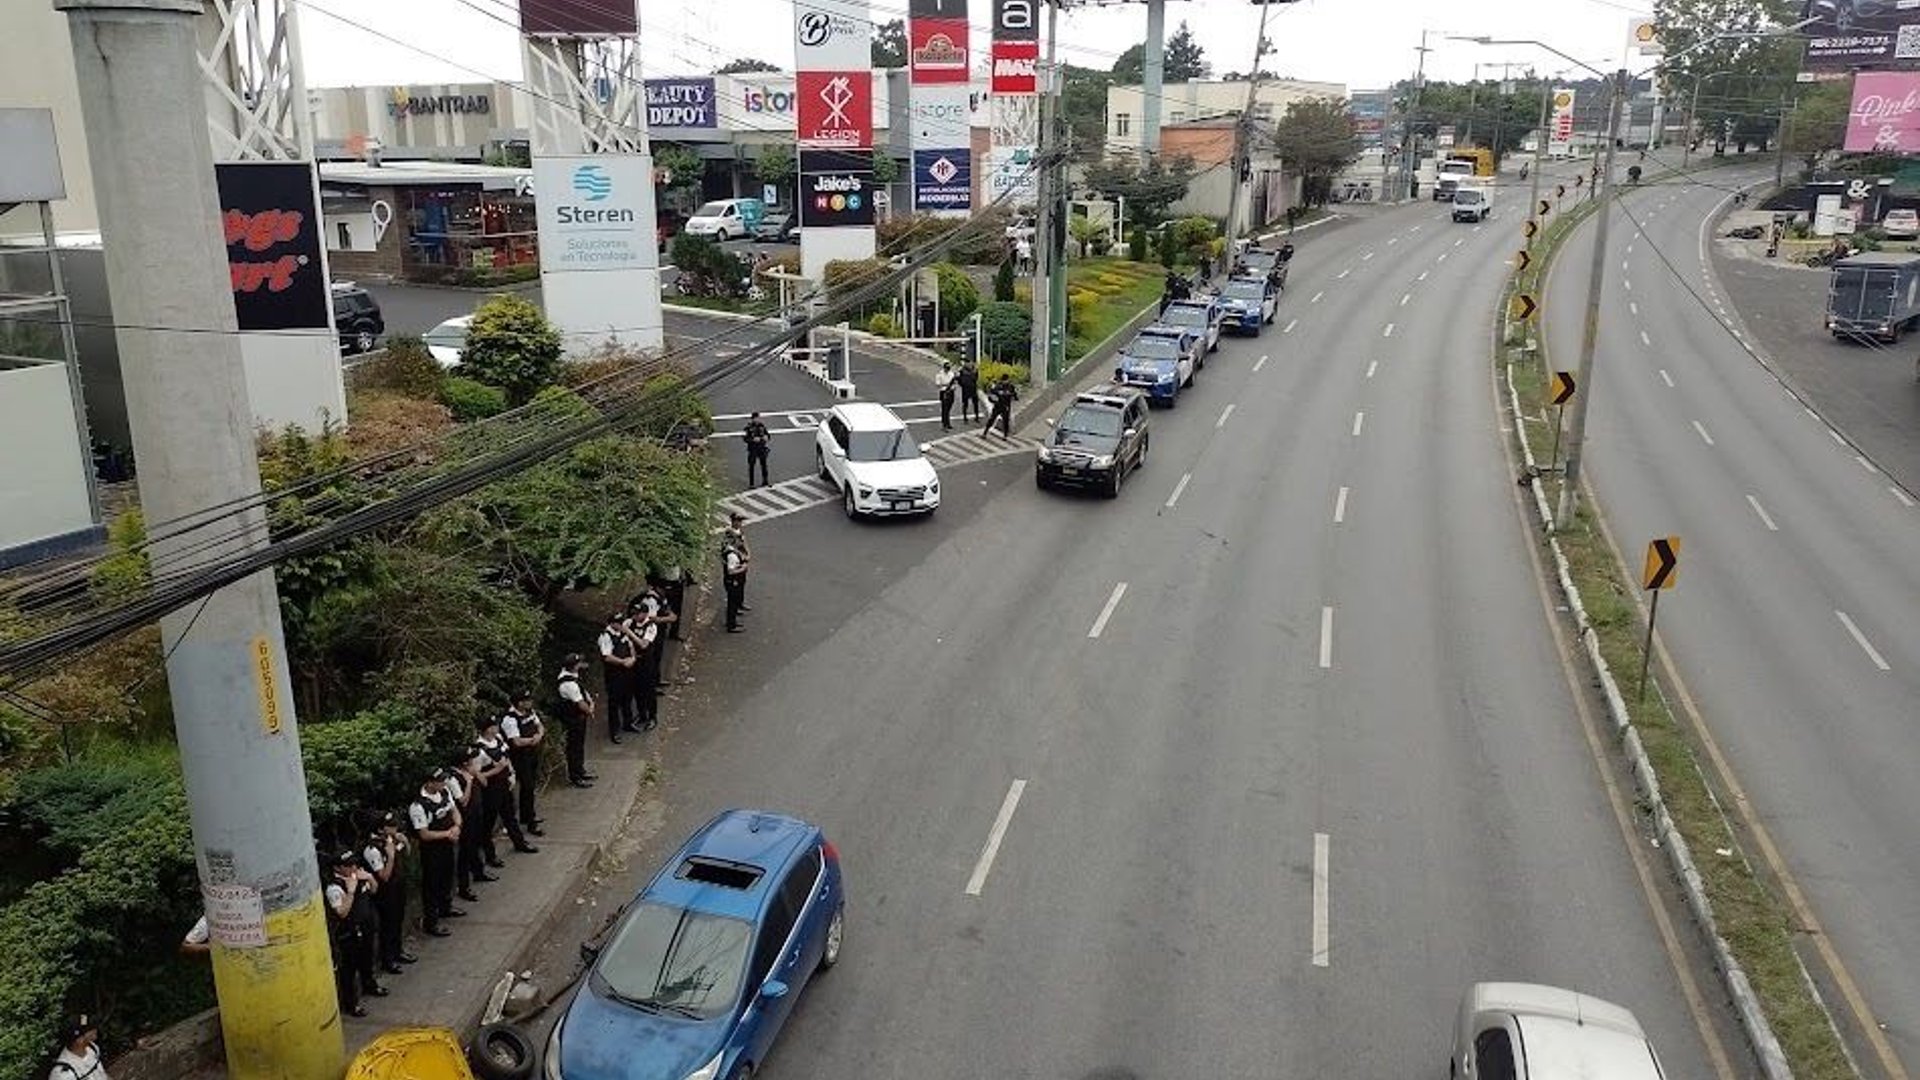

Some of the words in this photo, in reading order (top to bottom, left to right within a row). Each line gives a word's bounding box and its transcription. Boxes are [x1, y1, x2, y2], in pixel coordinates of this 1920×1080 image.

[994, 59, 1035, 76] MAX
[646, 85, 706, 103] EAUTY
[744, 86, 795, 112] istor
[409, 95, 488, 114] BANTRAB
[915, 101, 963, 117] istore
[649, 107, 706, 124] DEPOT
[814, 130, 860, 139] LEGION
[814, 175, 861, 191] Jake's
[557, 206, 633, 223] Steren
